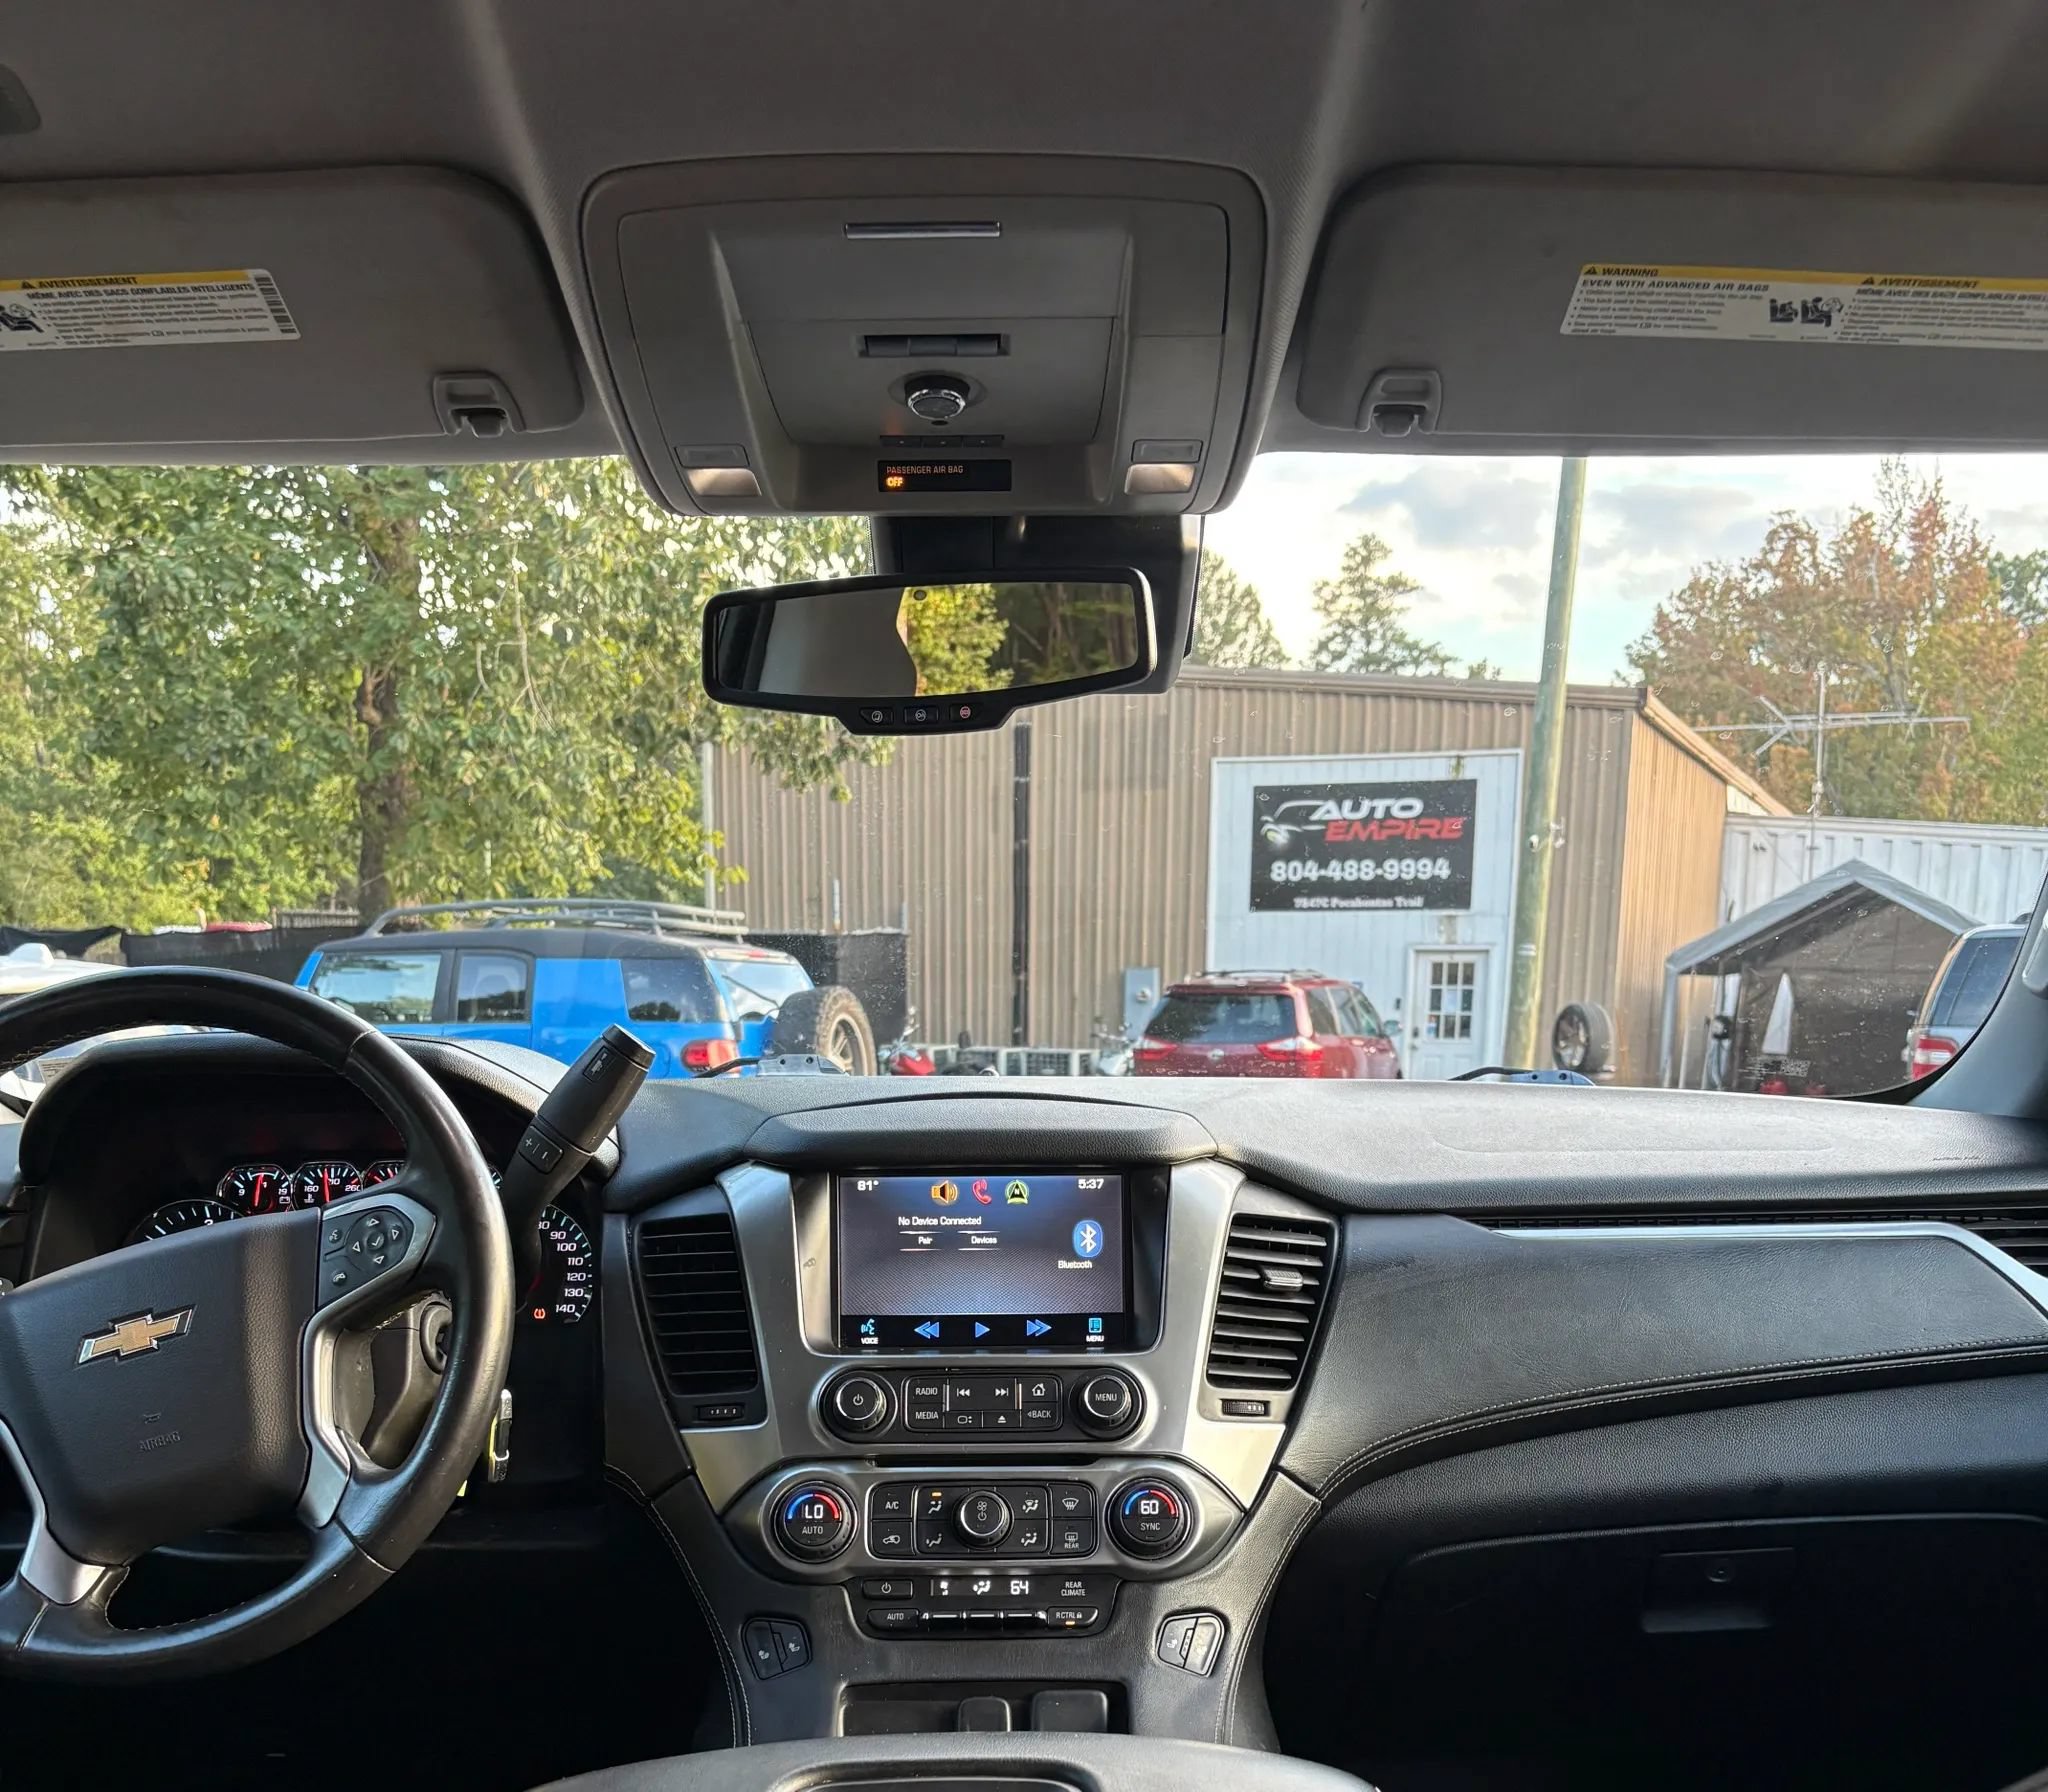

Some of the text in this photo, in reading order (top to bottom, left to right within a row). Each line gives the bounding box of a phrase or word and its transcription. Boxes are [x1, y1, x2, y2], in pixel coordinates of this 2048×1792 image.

[1602, 267, 1659, 277] WARNING
[37, 277, 138, 289] AVERTISSEMENT
[1582, 279, 1612, 287] EVEN
[1615, 280, 1645, 288] WITH
[1648, 281, 1710, 291] ADVANCED
[1878, 277, 1980, 289] AVERTISSEMENT
[190, 283, 255, 293] INTELLIGENTS
[886, 466, 931, 474] PASSENGER
[948, 465, 964, 473] BAG
[886, 476, 903, 487] OFF
[1310, 797, 1424, 821] AUTO
[1325, 816, 1466, 842] EMPIRE
[1270, 857, 1451, 882] 804-488-9994
[1395, 896, 1424, 908] Trail
[857, 1180, 879, 1191] 81°
[1078, 1178, 1104, 1189] 5:37
[304, 1185, 319, 1193] 160
[898, 1216, 982, 1225] No Device Connected
[550, 1231, 566, 1239] 90
[918, 1236, 933, 1245] Pair
[971, 1236, 997, 1244] Devices
[556, 1243, 577, 1251] 100
[567, 1257, 584, 1266] 110
[1058, 1260, 1092, 1269] Bluetooth
[566, 1272, 586, 1281] 120
[564, 1288, 584, 1297] 130
[555, 1304, 576, 1313] 140
[915, 1387, 938, 1395] RADIO
[1095, 1393, 1117, 1401] MENU
[915, 1411, 939, 1420] MEDIA
[1032, 1410, 1052, 1418] BACK
[885, 1501, 899, 1510] A/C
[1140, 1500, 1159, 1515] 60
[805, 1504, 824, 1519] LO
[802, 1526, 824, 1535] AUTO
[1140, 1522, 1160, 1531] SYNC
[1010, 1580, 1029, 1595] 64
[1065, 1581, 1082, 1589] REAR
[1060, 1588, 1086, 1597] CLIMATE
[886, 1612, 904, 1621] AUTO
